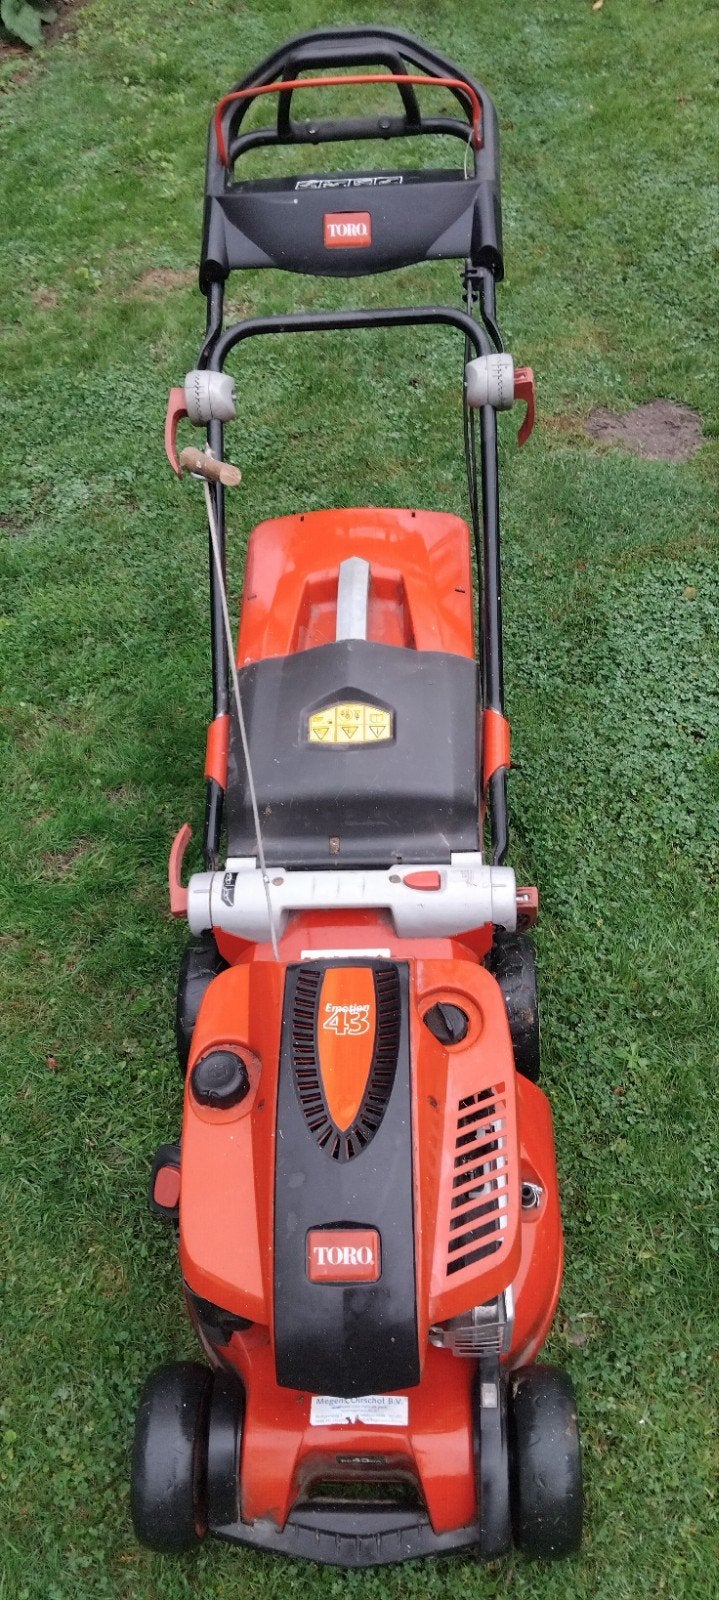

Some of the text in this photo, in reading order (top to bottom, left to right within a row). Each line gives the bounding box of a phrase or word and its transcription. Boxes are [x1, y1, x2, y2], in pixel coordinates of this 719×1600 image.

[328, 222, 368, 238] TORO
[325, 1003, 370, 1013] Emotion
[322, 1010, 370, 1036] 43
[313, 1246, 374, 1266] TORO
